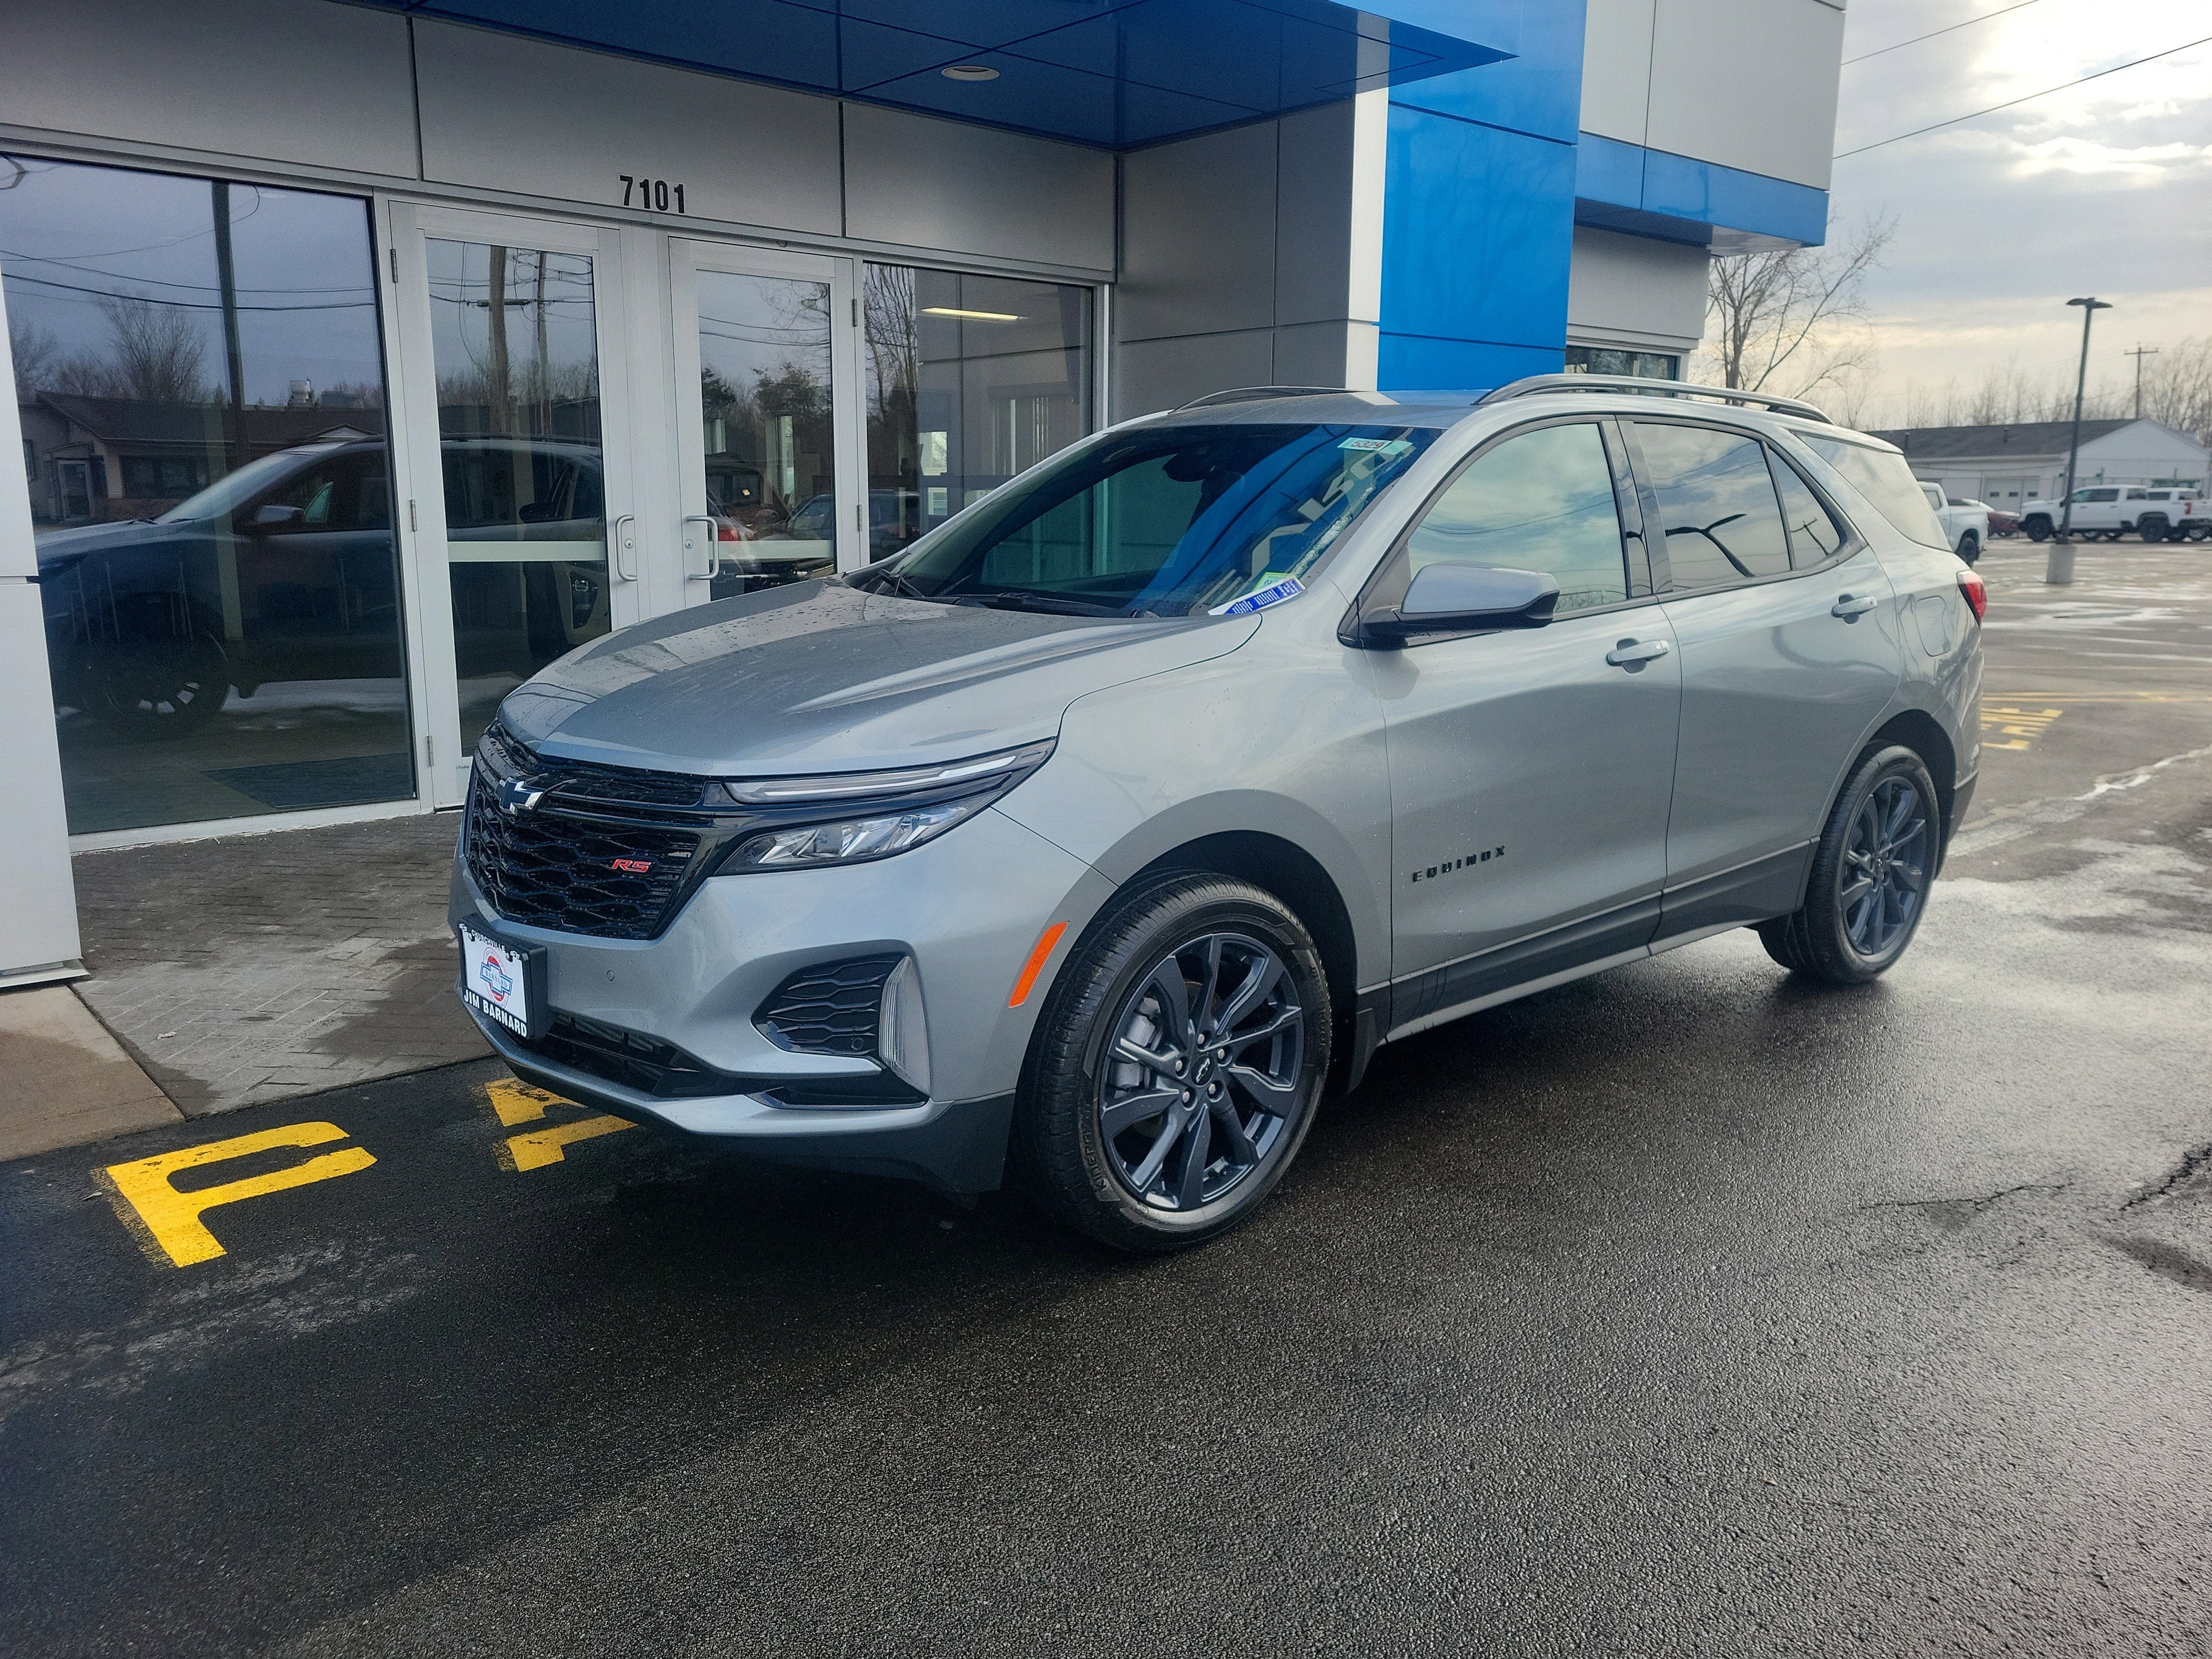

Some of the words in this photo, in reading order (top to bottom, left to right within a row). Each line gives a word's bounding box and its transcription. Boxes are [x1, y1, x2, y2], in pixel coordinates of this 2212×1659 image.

[620, 175, 684, 213] 7101
[1351, 440, 1384, 449] 5329
[612, 859, 651, 873] RS
[1412, 845, 1505, 882] EQUINOX
[471, 930, 505, 952] CHURCHVILLE
[463, 989, 479, 1009] JIM
[483, 999, 527, 1037] BARNARD
